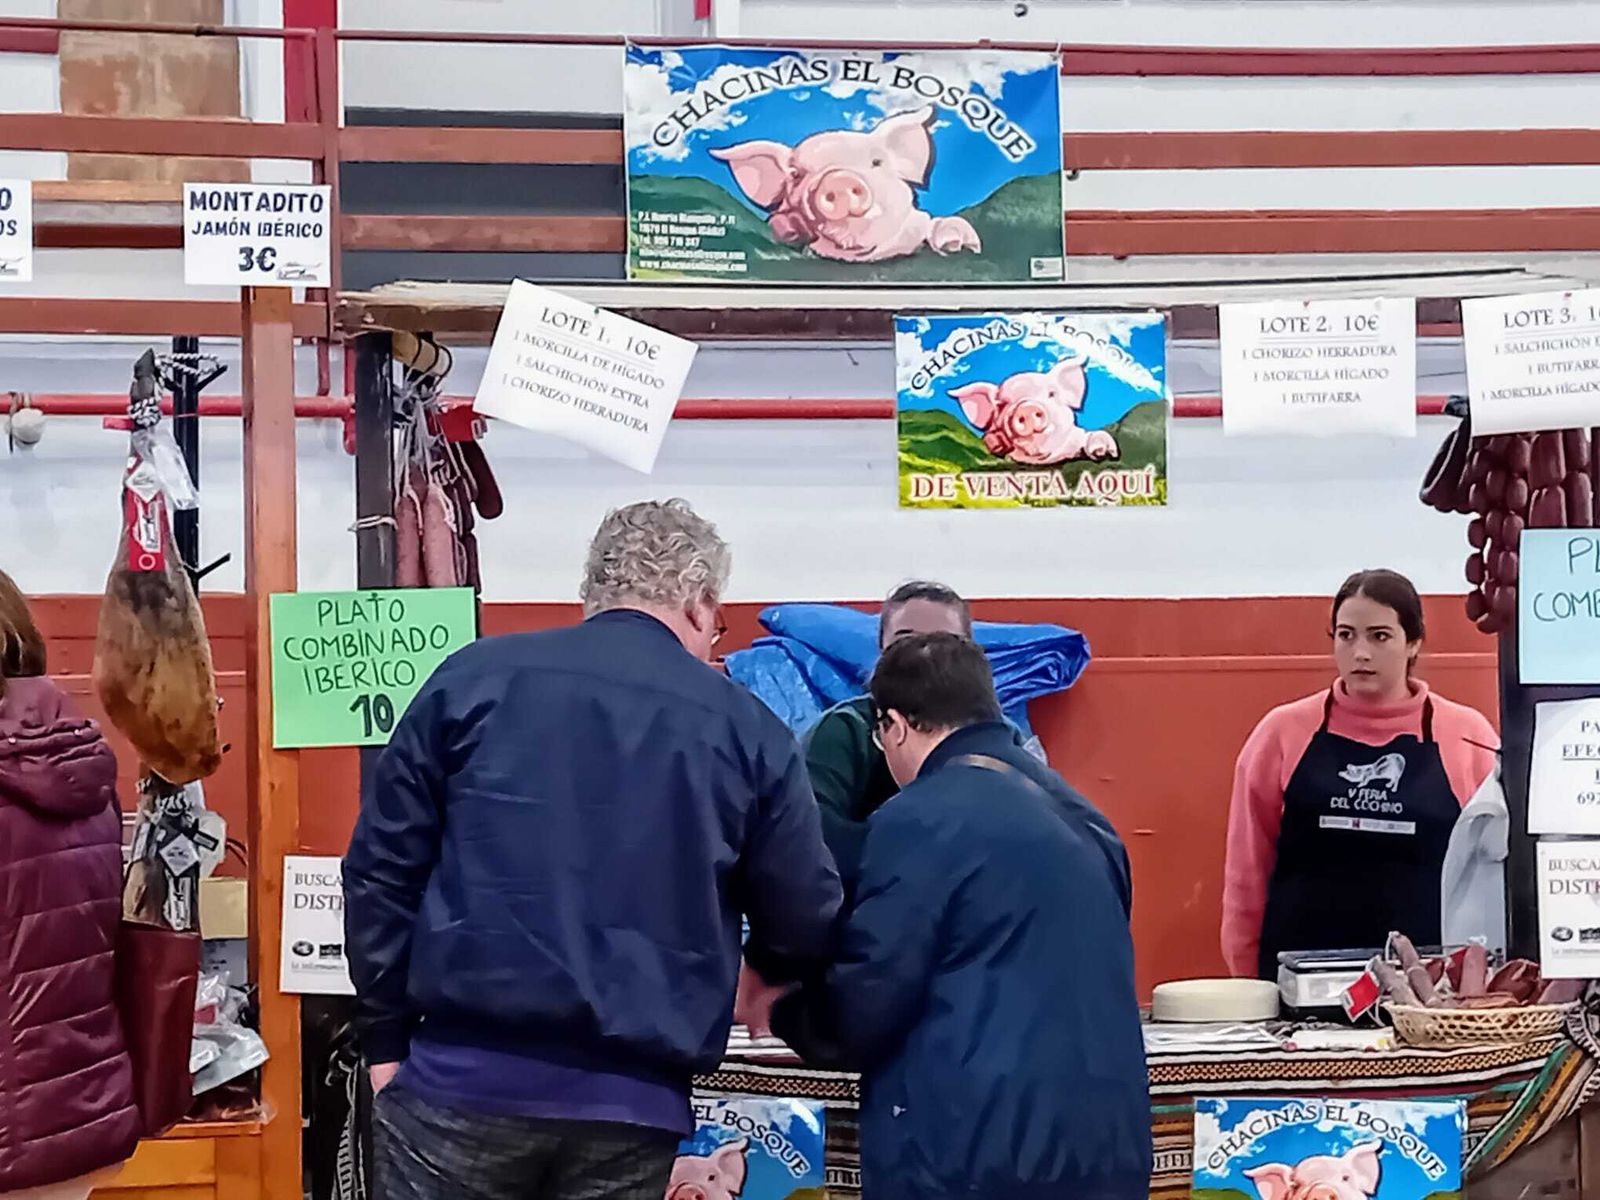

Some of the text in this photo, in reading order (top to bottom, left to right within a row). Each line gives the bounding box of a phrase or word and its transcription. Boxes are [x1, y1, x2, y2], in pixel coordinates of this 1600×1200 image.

[653, 59, 1033, 159] CHACINAS EL BOSQUE
[190, 191, 323, 213] MONTADITO
[192, 217, 323, 238] JAMÓN IBÉRICO
[238, 246, 277, 272] 3€
[541, 307, 592, 337] LOTE
[626, 337, 662, 360] 10€
[1259, 316, 1311, 333] LOTE
[1344, 314, 1381, 332] 10€
[1504, 308, 1555, 329] LOTE
[524, 332, 589, 363] MORCILLA
[592, 355, 611, 369] DE
[911, 321, 1024, 391] CHACINAS
[1252, 347, 1314, 360] CHORIZO
[1317, 345, 1398, 359] HERRADURA
[1263, 369, 1330, 382] MORCILLA
[511, 376, 572, 405] CHORIZO
[573, 397, 650, 433] HERRADURA
[611, 386, 650, 409] EXTRA
[1291, 392, 1362, 404] BUTIFARRA
[1490, 386, 1553, 400] MORCILLA
[913, 467, 1155, 503] DE VENTA AQUÍ
[317, 596, 405, 627] PLATO
[284, 624, 449, 661] COMBINADO
[350, 693, 395, 738] 10
[693, 1105, 809, 1176] EL BOSQUE
[1207, 1104, 1446, 1179] CHACINAS EL BOSQUE
